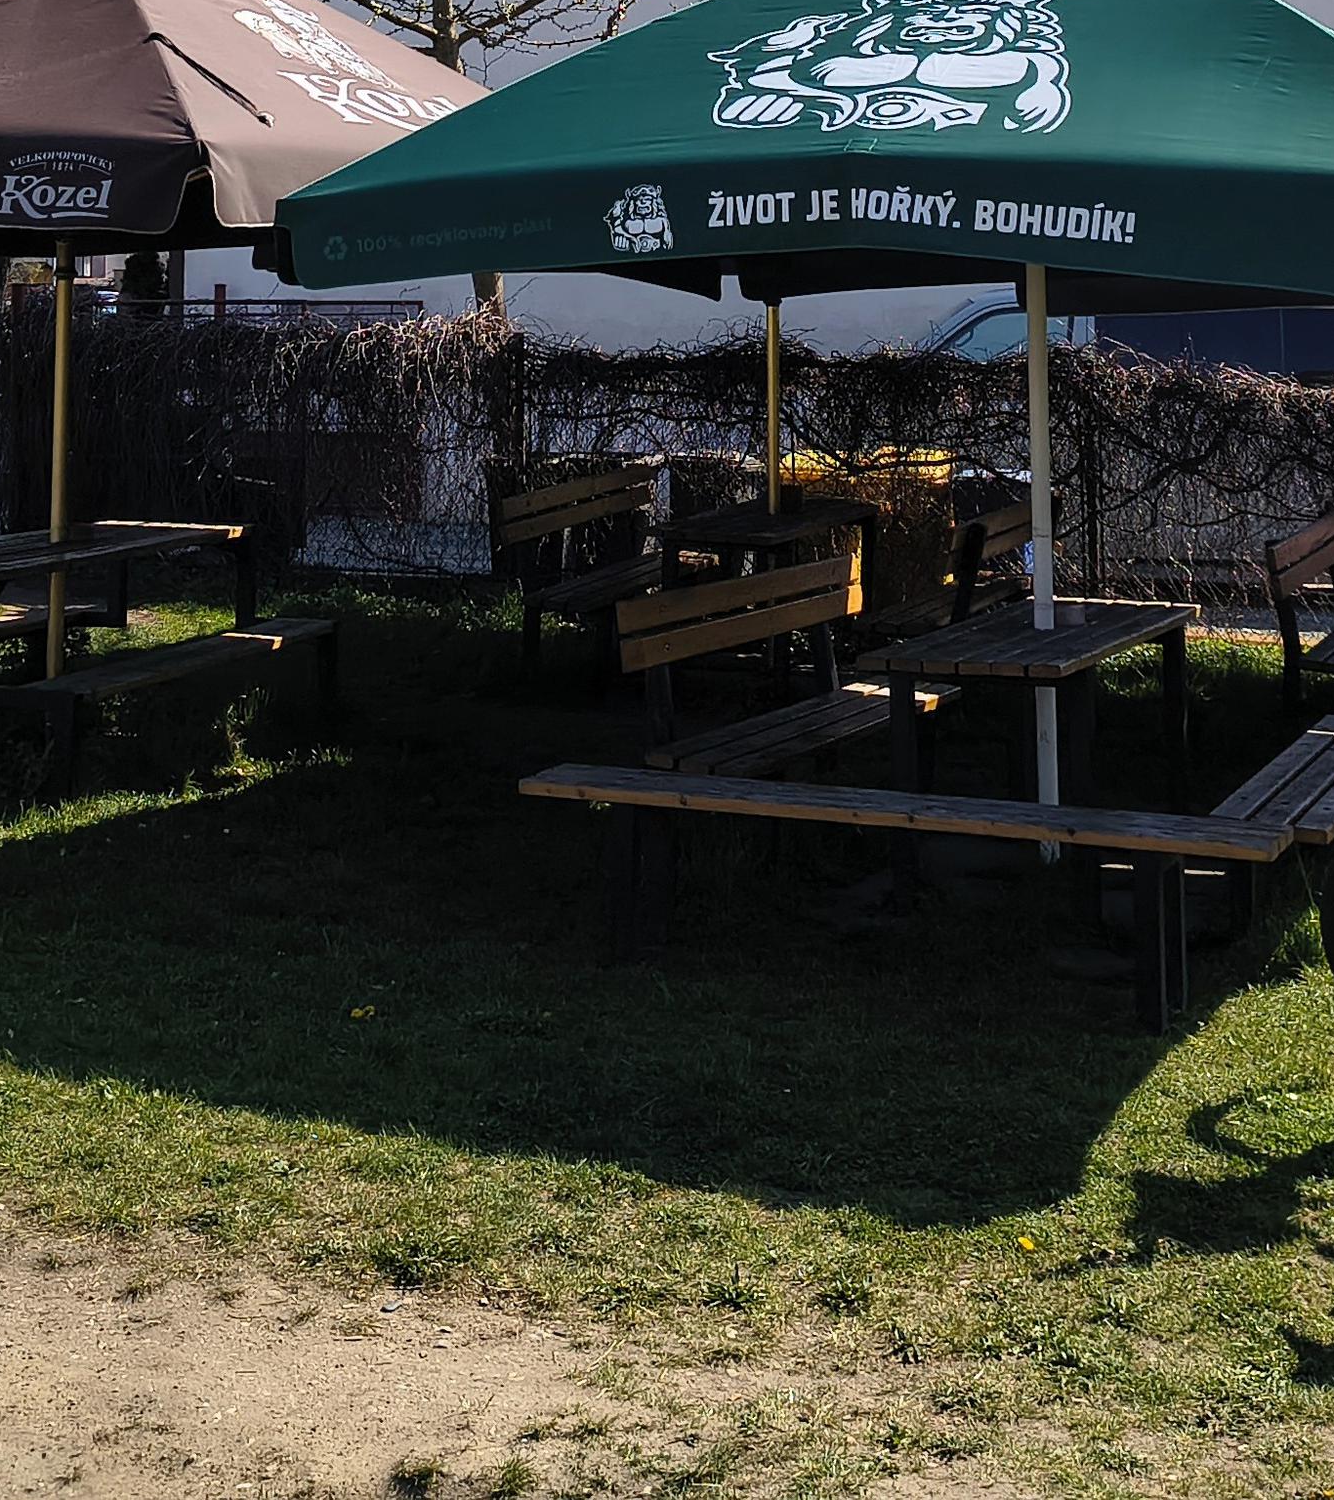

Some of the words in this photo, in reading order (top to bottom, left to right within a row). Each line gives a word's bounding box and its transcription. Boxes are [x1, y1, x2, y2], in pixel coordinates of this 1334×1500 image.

[708, 190, 795, 228] ŽIVOT
[806, 188, 841, 222] JE
[851, 186, 961, 229] HOŘKÝ.
[974, 200, 1136, 244] BOHUDÍK!
